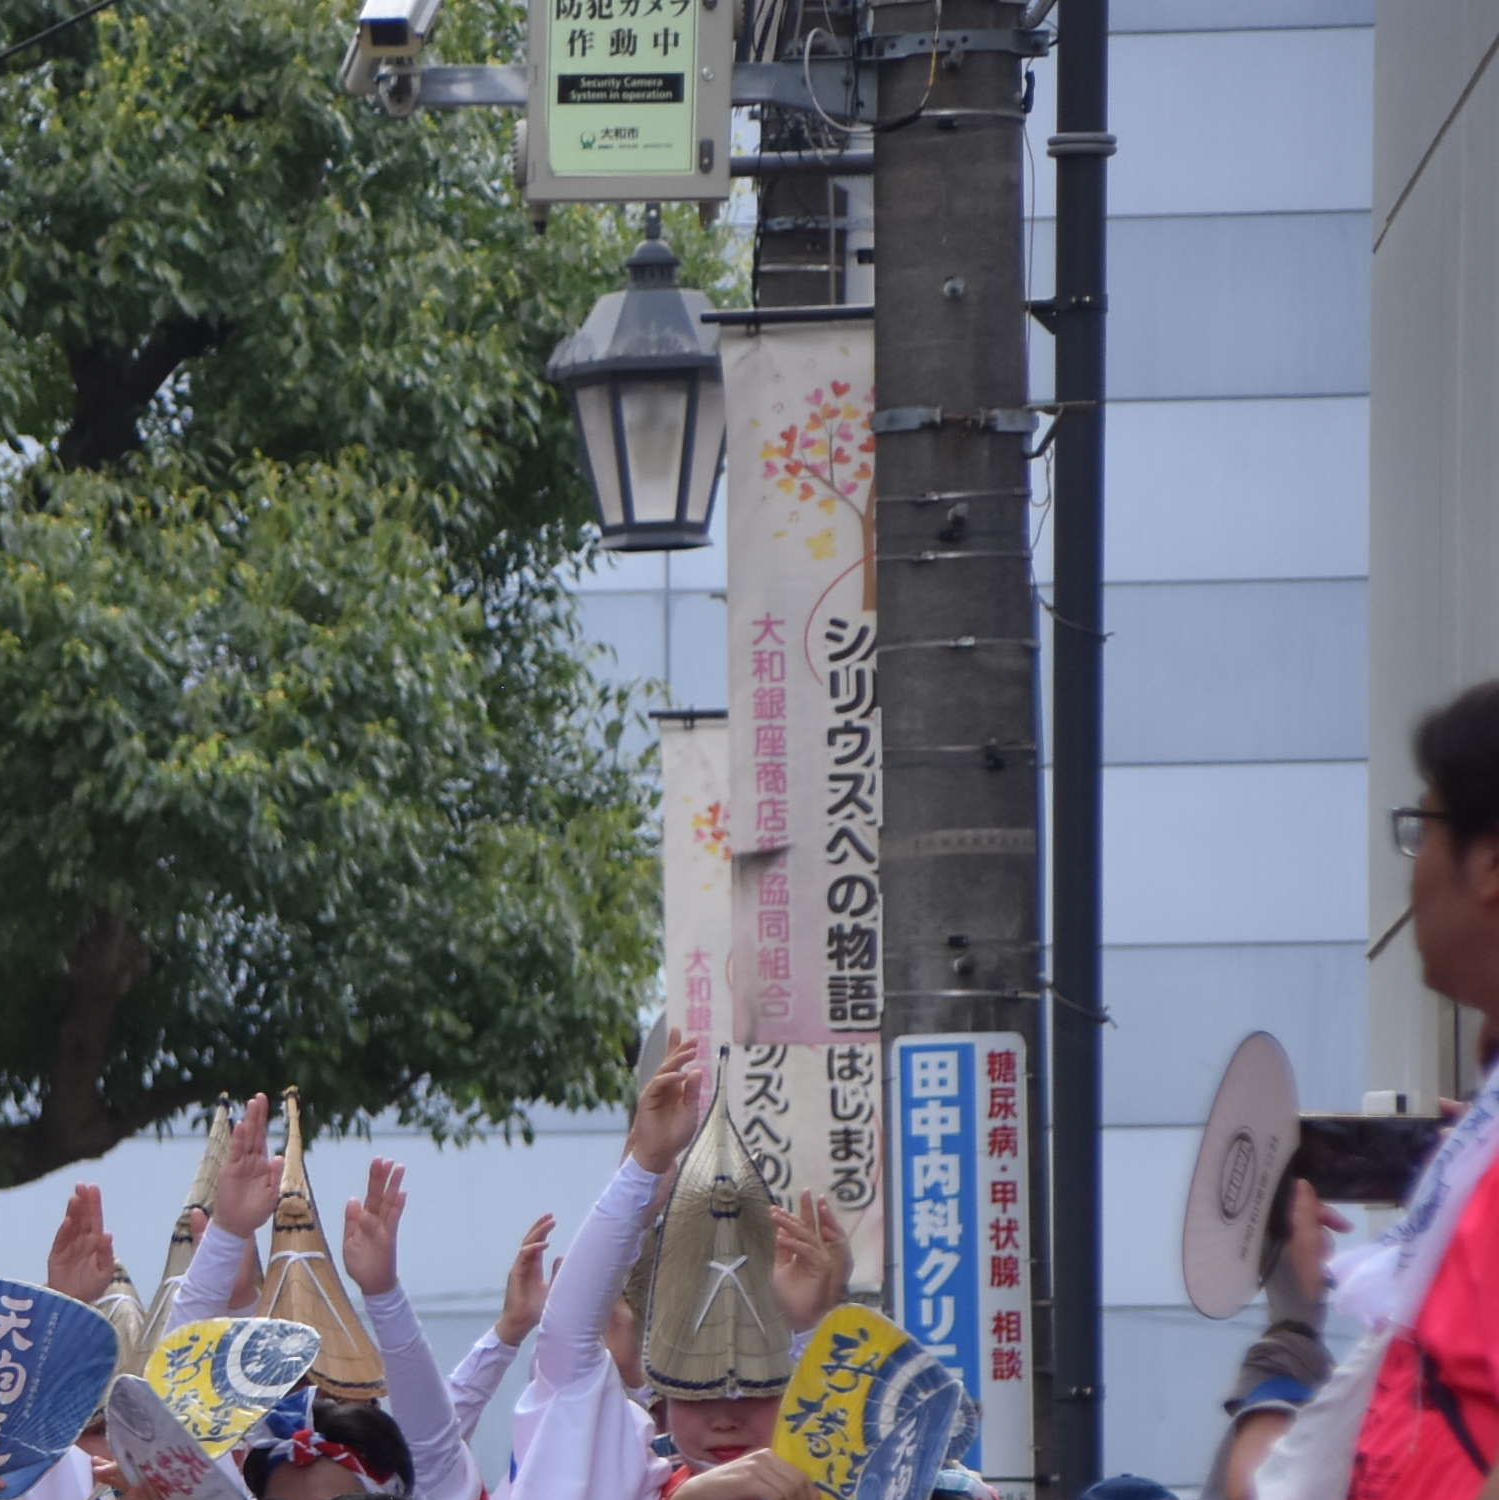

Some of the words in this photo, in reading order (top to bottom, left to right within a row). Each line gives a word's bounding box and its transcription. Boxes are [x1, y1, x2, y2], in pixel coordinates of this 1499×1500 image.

[570, 89, 607, 101] System
[609, 90, 619, 100] in
[622, 89, 673, 101] operation
[579, 77, 621, 89] Security
[623, 76, 663, 88] Camera
[601, 127, 639, 140] 大和市
[825, 616, 878, 1022] シリウスへの物語
[987, 1049, 1020, 1289] 糖尿病・甲状腺
[991, 1310, 1023, 1381] 相談
